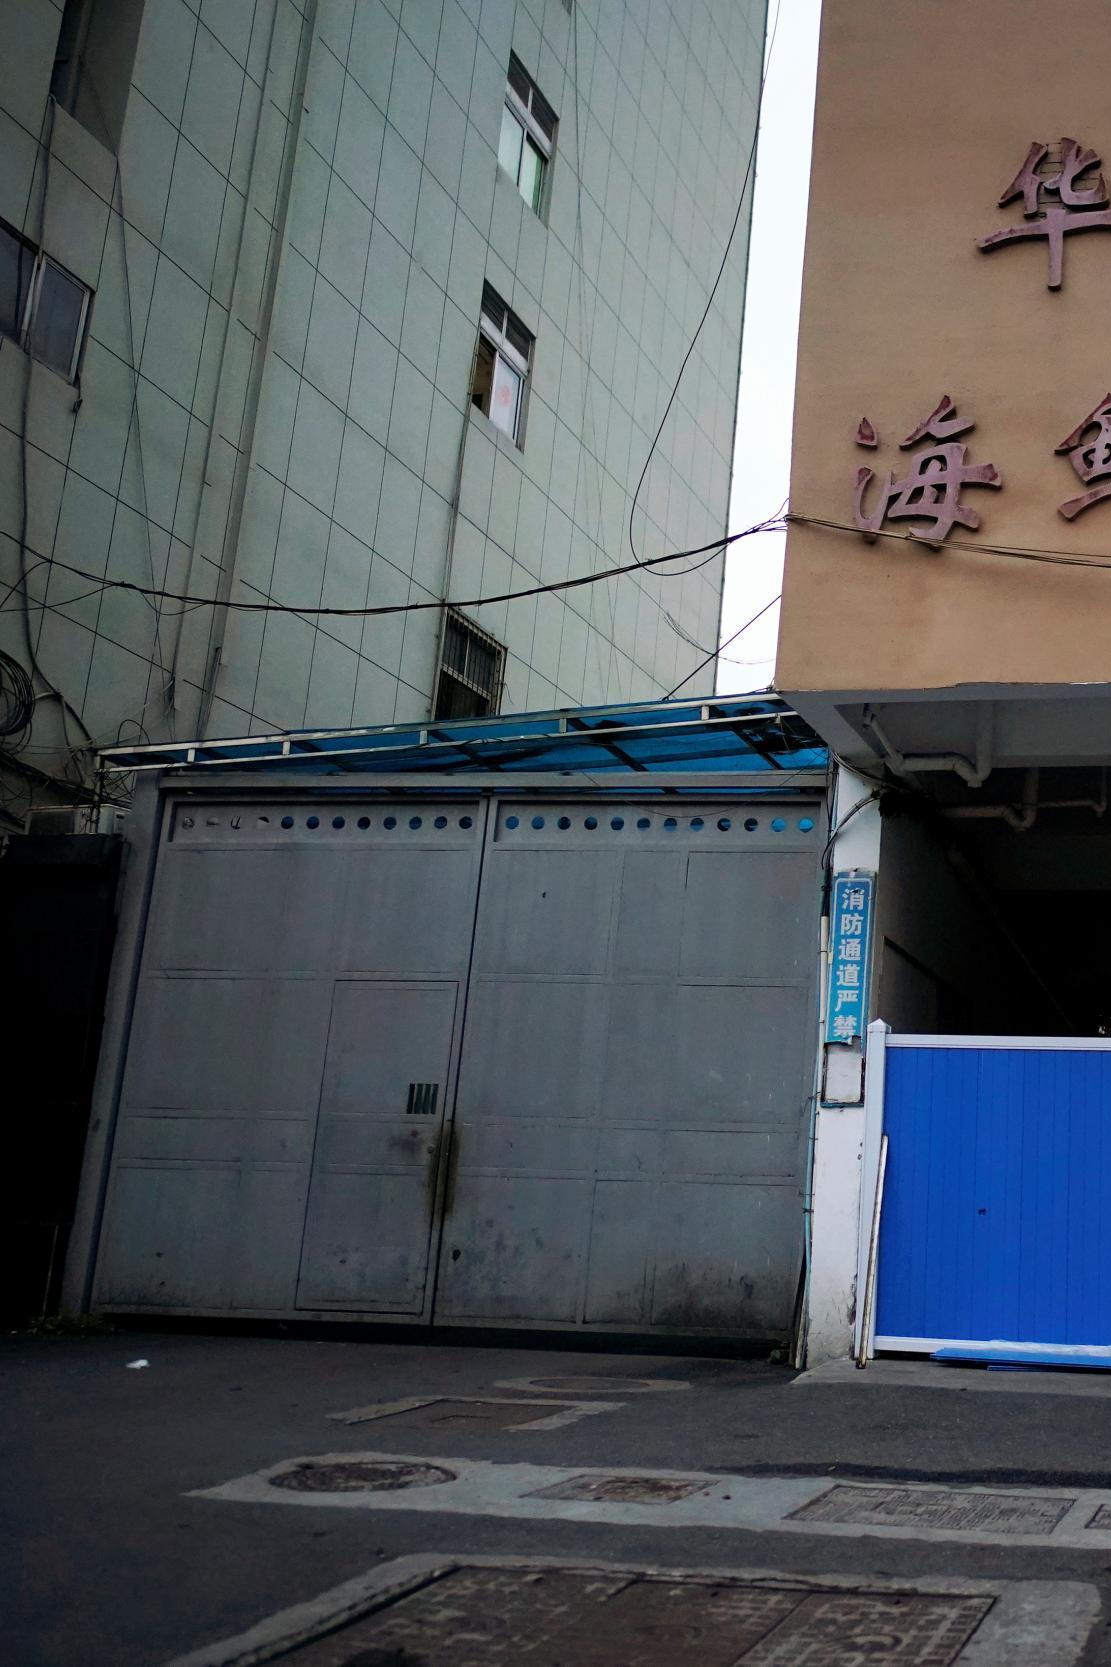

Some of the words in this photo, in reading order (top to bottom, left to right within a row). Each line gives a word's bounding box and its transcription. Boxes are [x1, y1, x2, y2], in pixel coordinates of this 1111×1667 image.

[833, 888, 865, 1043] 消防通道严禁
